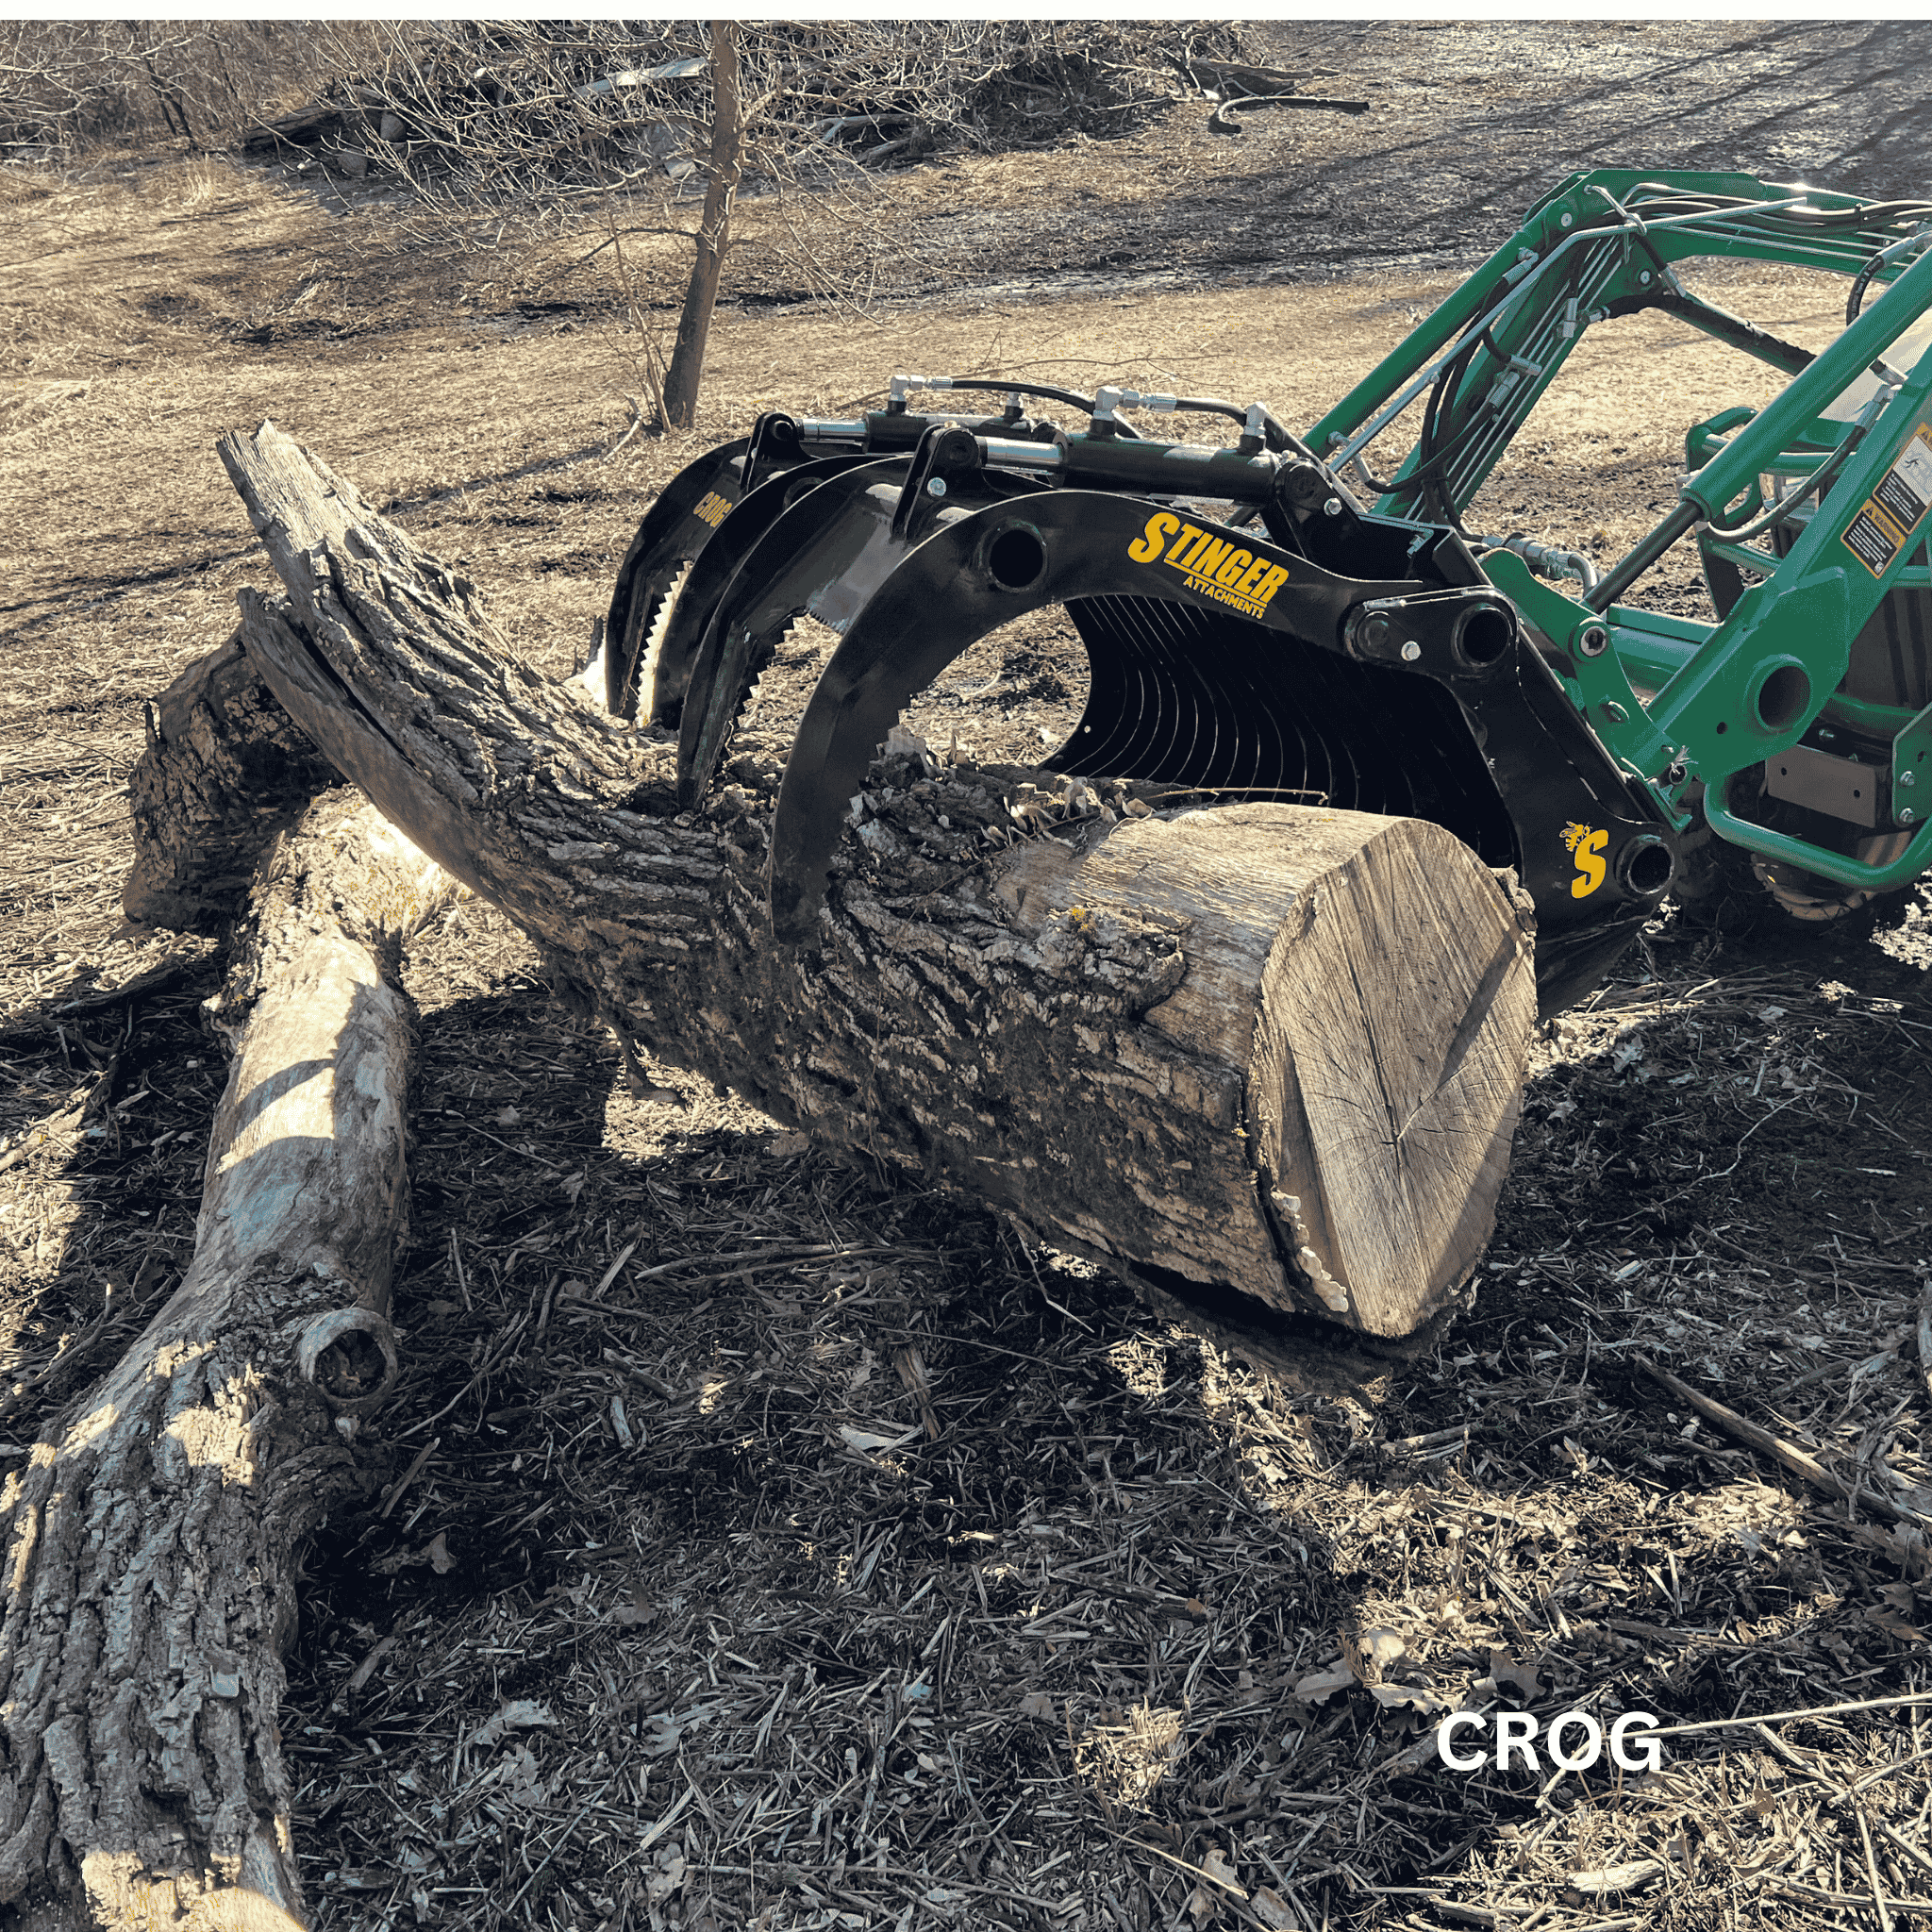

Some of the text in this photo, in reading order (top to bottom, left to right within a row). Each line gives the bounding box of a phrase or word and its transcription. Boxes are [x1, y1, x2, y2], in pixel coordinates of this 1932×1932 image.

[692, 491, 733, 528] CROG
[1127, 511, 1290, 604] STINGER
[1182, 575, 1265, 620] ATTACHMENTS
[1571, 828, 1609, 899] S
